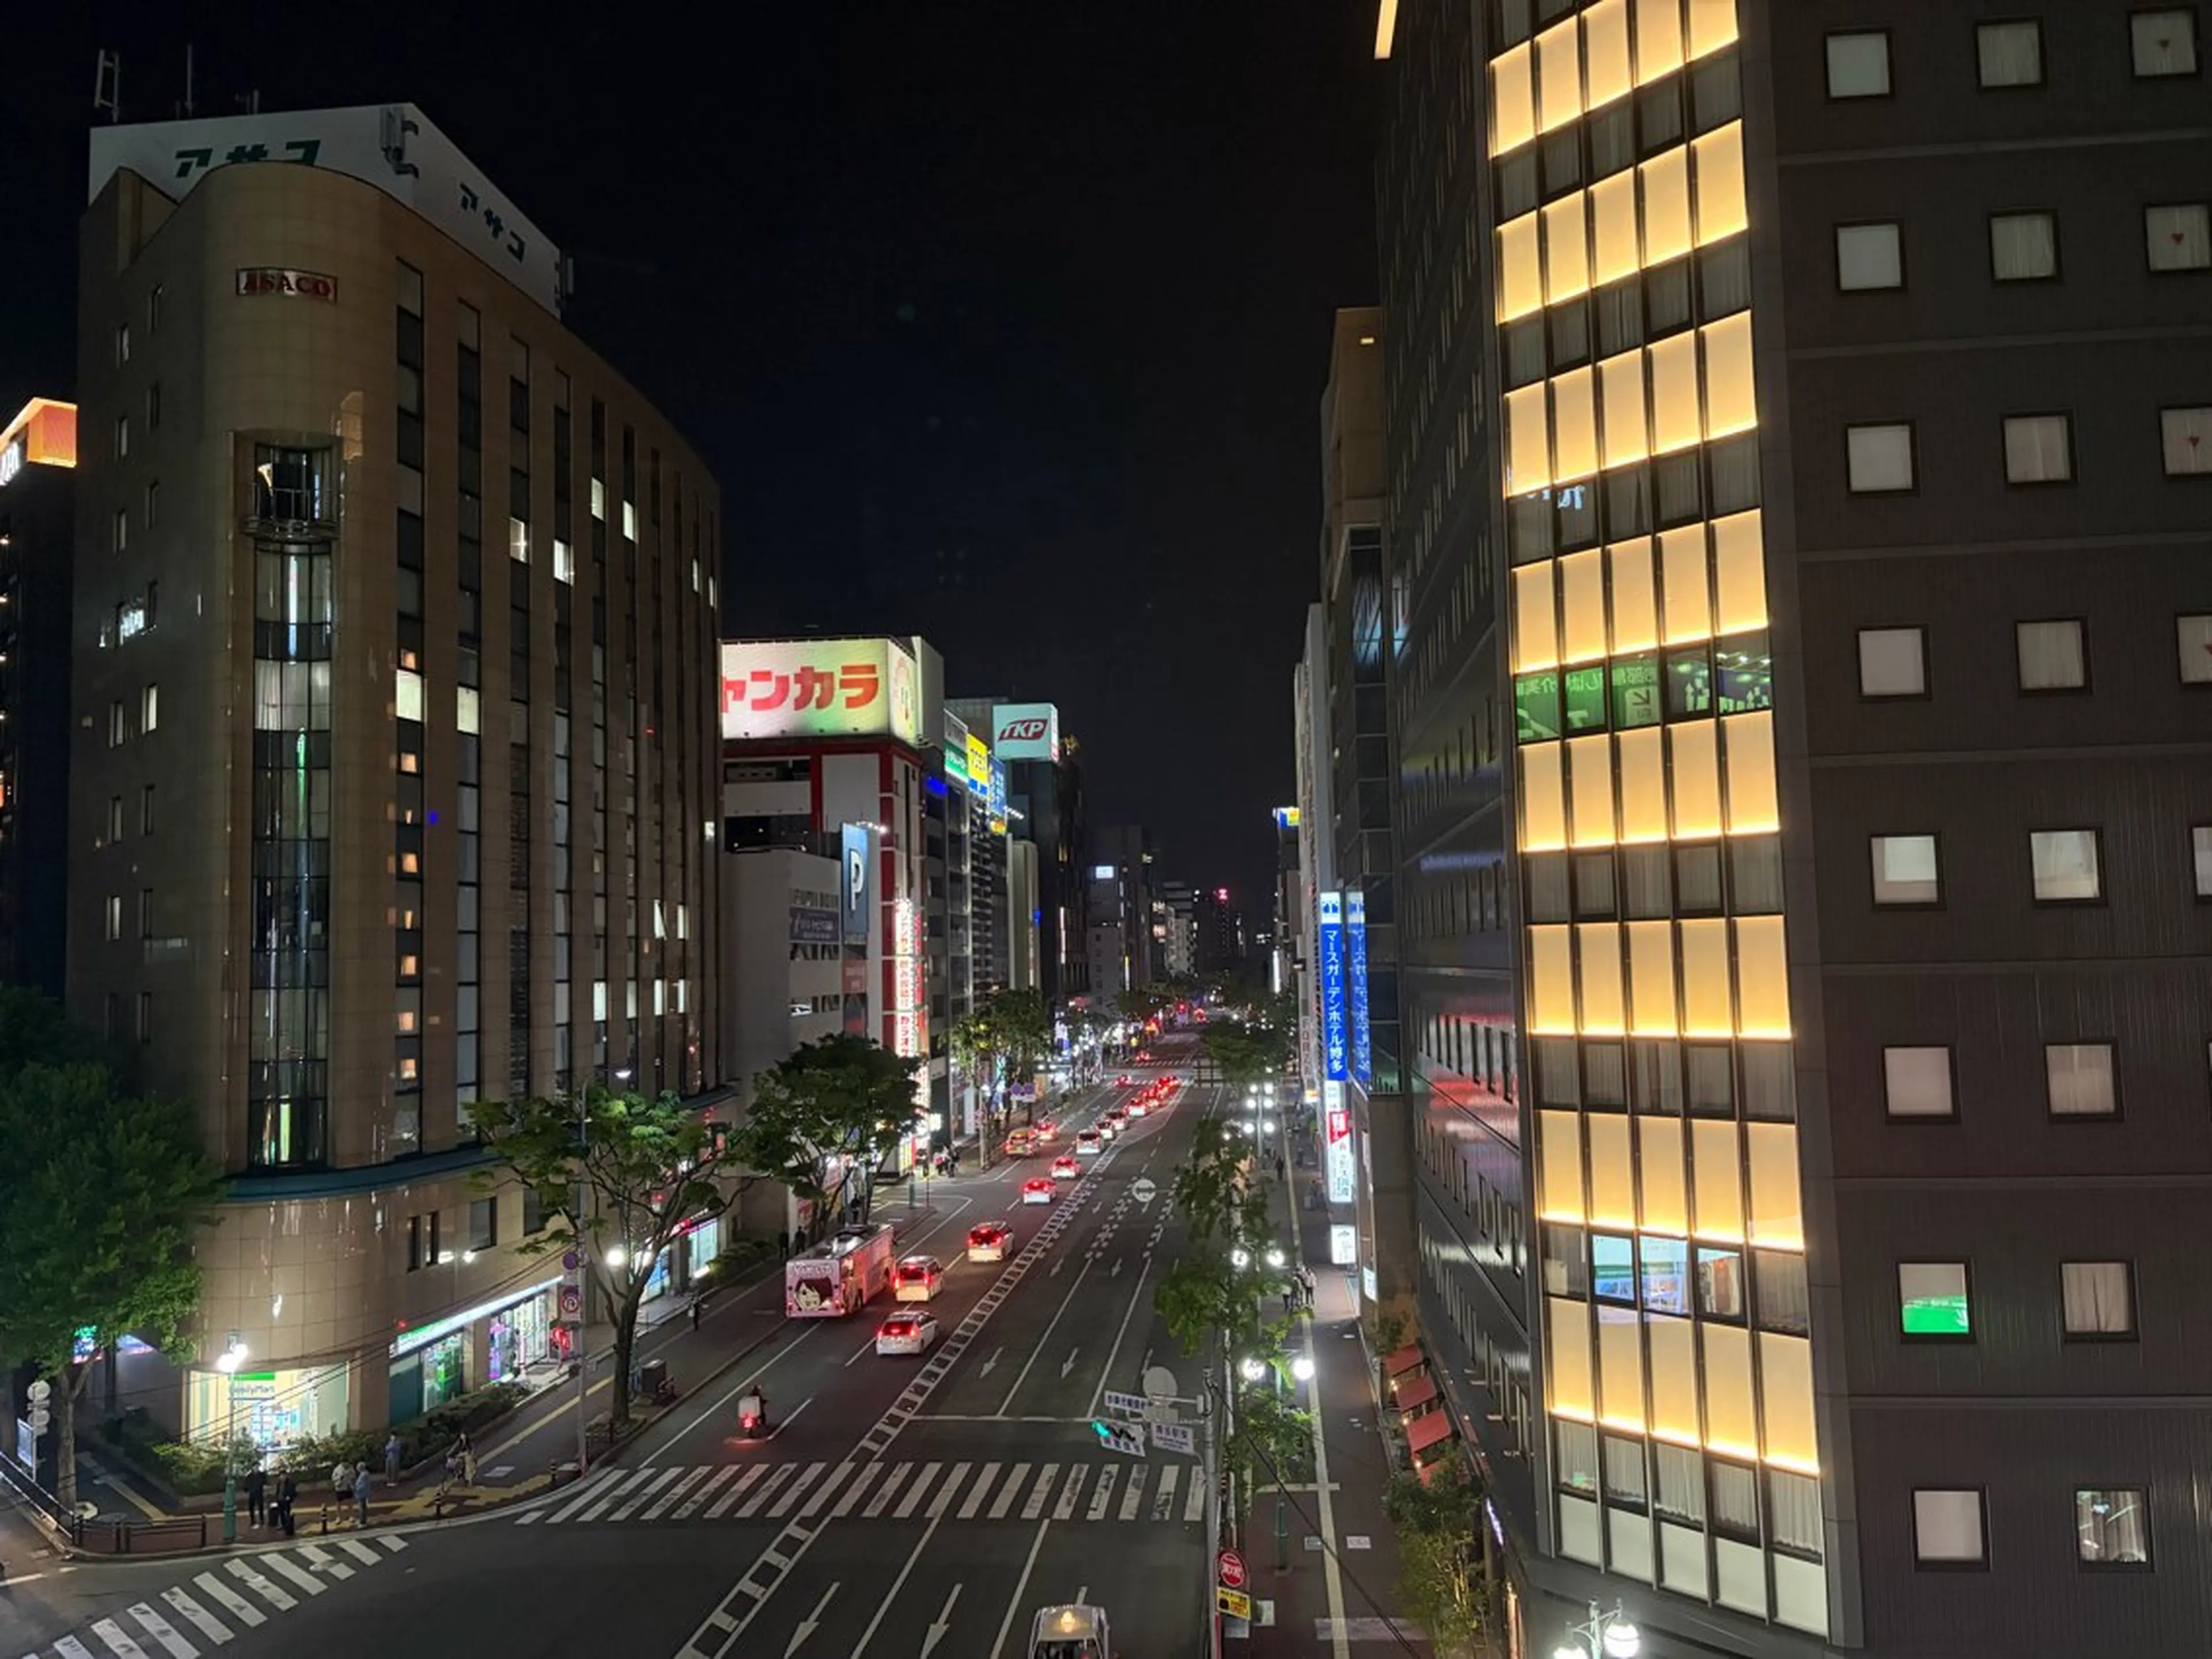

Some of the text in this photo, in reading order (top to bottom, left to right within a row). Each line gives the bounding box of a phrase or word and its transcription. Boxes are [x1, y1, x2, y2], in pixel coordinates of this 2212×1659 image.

[460, 182, 525, 264] アサコ
[1003, 721, 1045, 738] TKP
[850, 849, 864, 911] P
[1325, 930, 1344, 1073] マースガーデンホテル博多
